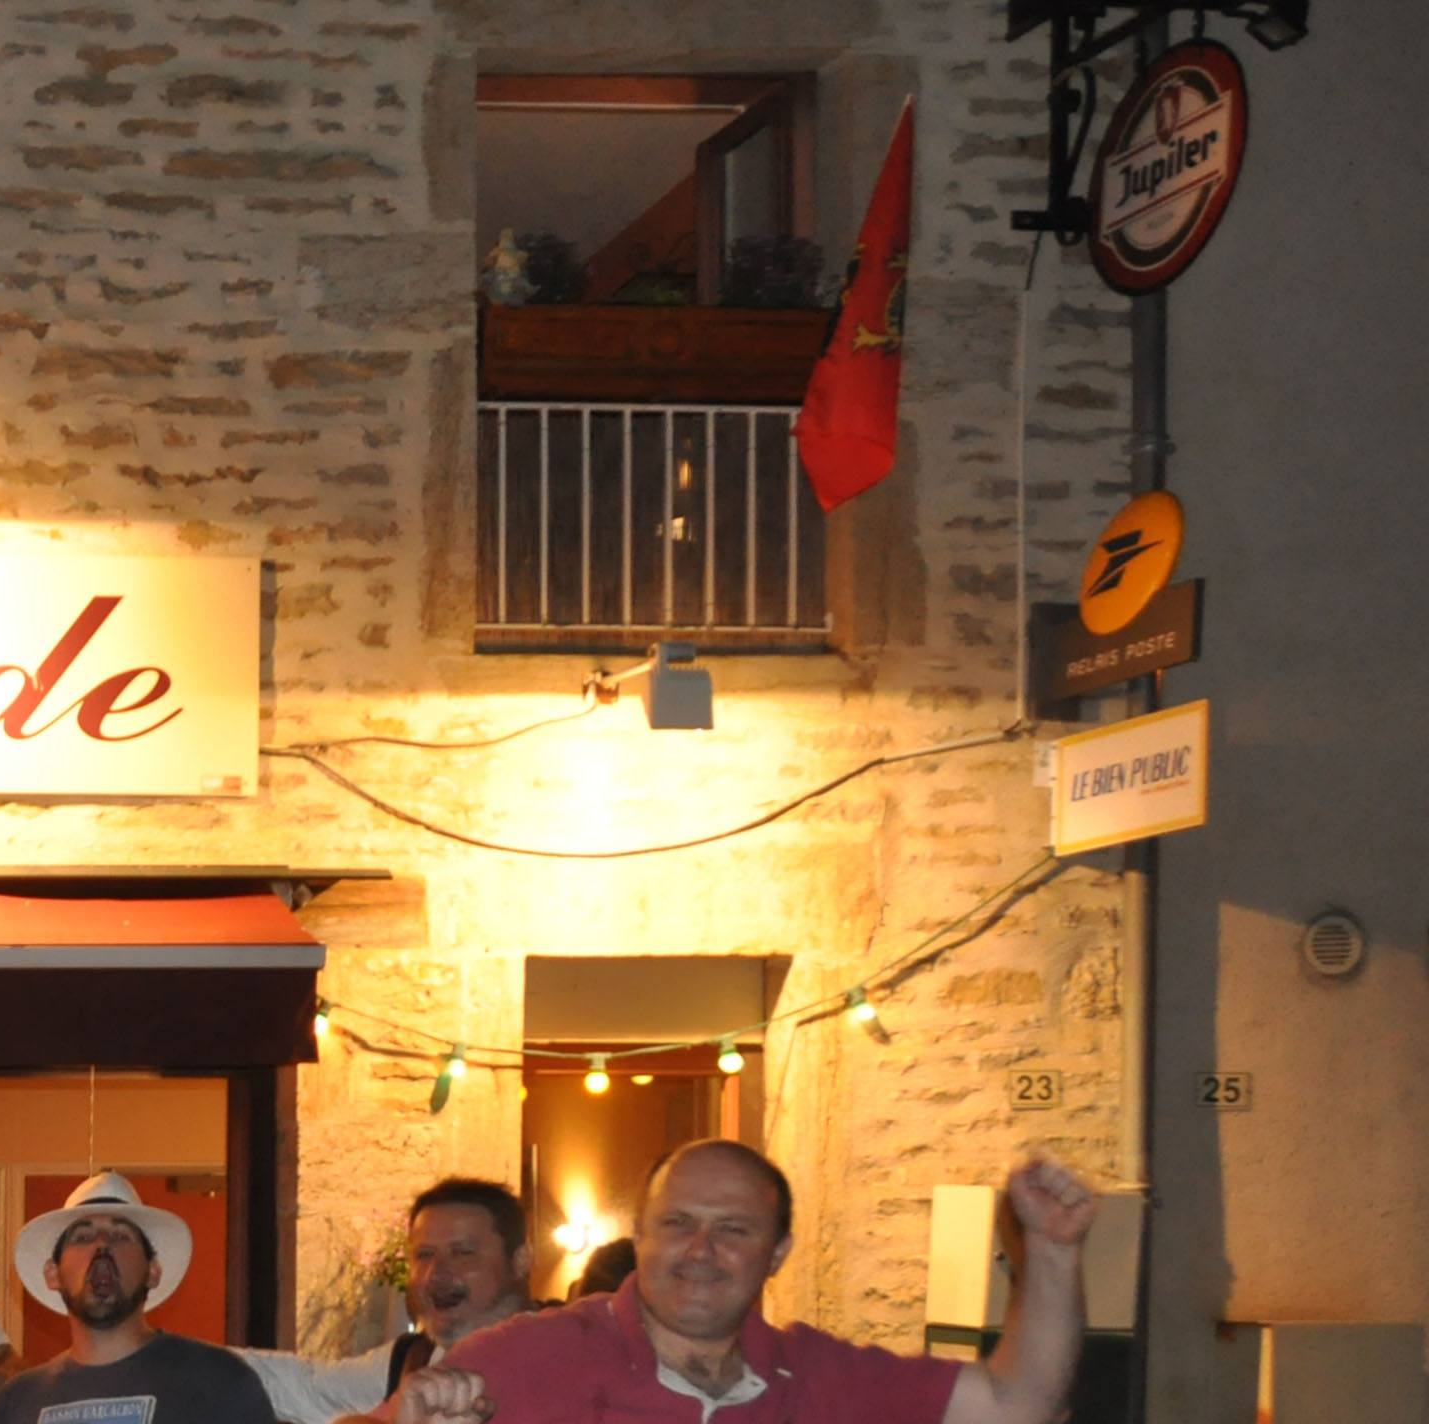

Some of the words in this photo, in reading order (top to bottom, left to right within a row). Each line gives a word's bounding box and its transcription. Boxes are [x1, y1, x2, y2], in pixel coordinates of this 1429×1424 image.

[1115, 129, 1218, 209] Jupiler
[1066, 649, 1119, 679] RELAIS
[1125, 631, 1177, 661] POSTE
[1071, 770, 1090, 802] LE
[1091, 763, 1126, 797] BIEN
[1129, 745, 1192, 789] PUBLIC
[1017, 1075, 1053, 1100] 23
[1202, 1077, 1241, 1103] 25
